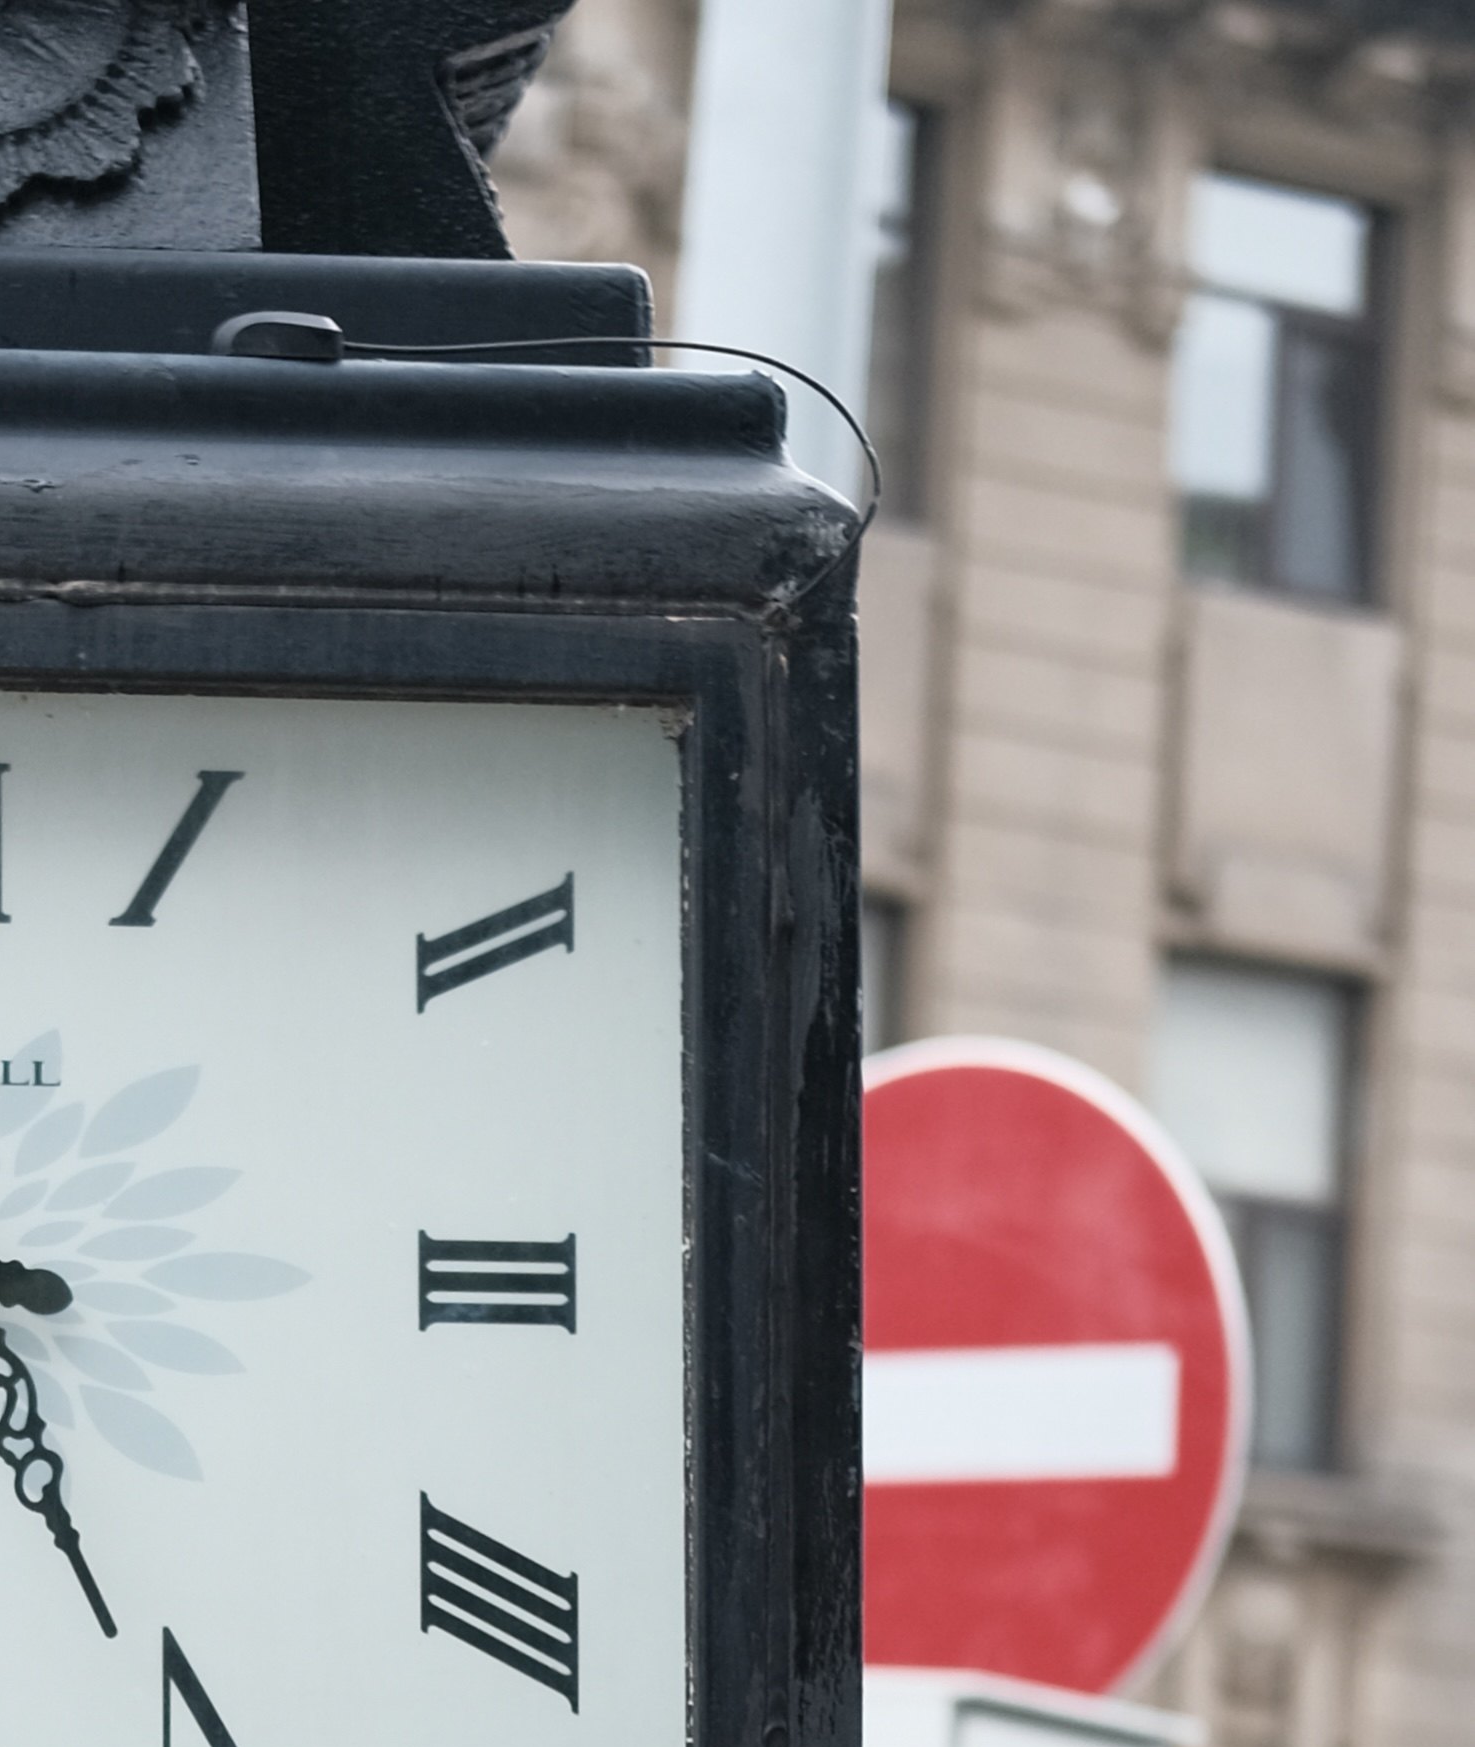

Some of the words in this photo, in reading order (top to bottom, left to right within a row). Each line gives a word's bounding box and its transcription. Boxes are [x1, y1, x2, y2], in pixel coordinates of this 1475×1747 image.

[108, 769, 246, 927] I
[416, 871, 575, 1014] II
[419, 1230, 577, 1334] III
